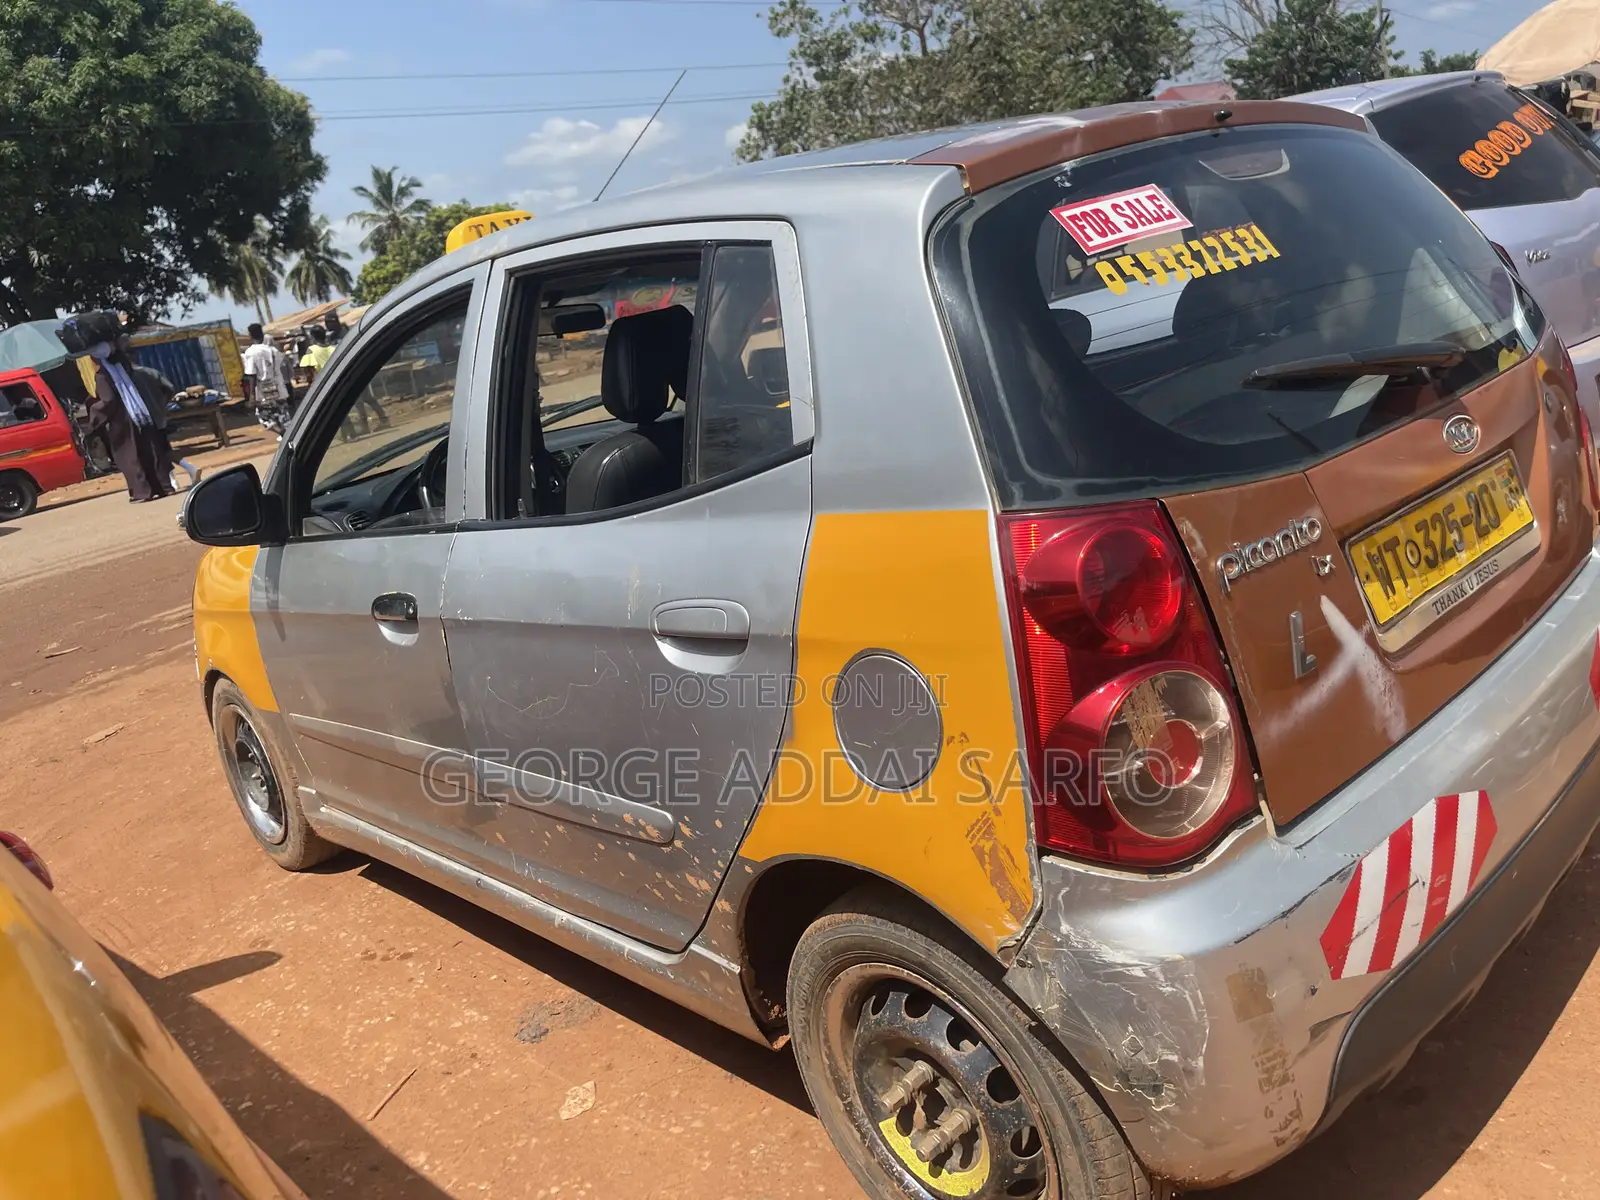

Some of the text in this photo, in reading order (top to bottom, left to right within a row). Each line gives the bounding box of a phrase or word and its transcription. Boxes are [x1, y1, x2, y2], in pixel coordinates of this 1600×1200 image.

[1458, 120, 1532, 179] GOOD
[1066, 194, 1177, 242] FOR SALE
[1095, 223, 1281, 296] 0553372531
[1216, 516, 1321, 593] picanto
[1432, 559, 1500, 615] THANK U JESUS
